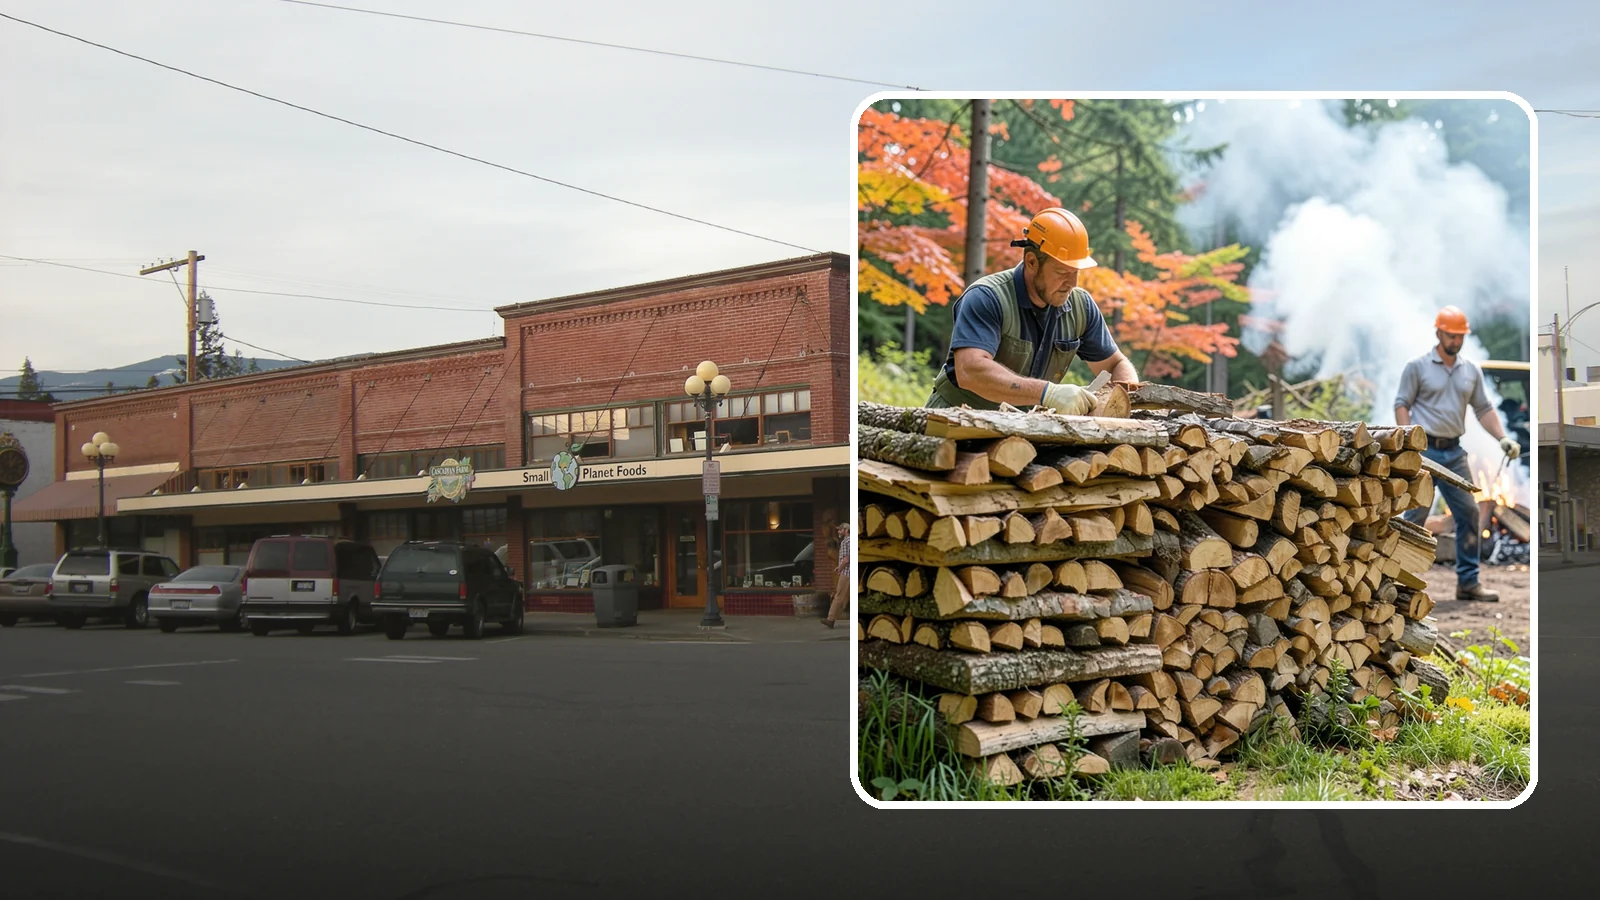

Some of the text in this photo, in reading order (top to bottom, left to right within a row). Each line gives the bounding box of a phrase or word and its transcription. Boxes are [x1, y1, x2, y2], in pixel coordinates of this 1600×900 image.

[523, 464, 647, 483] Small Planet Foods
